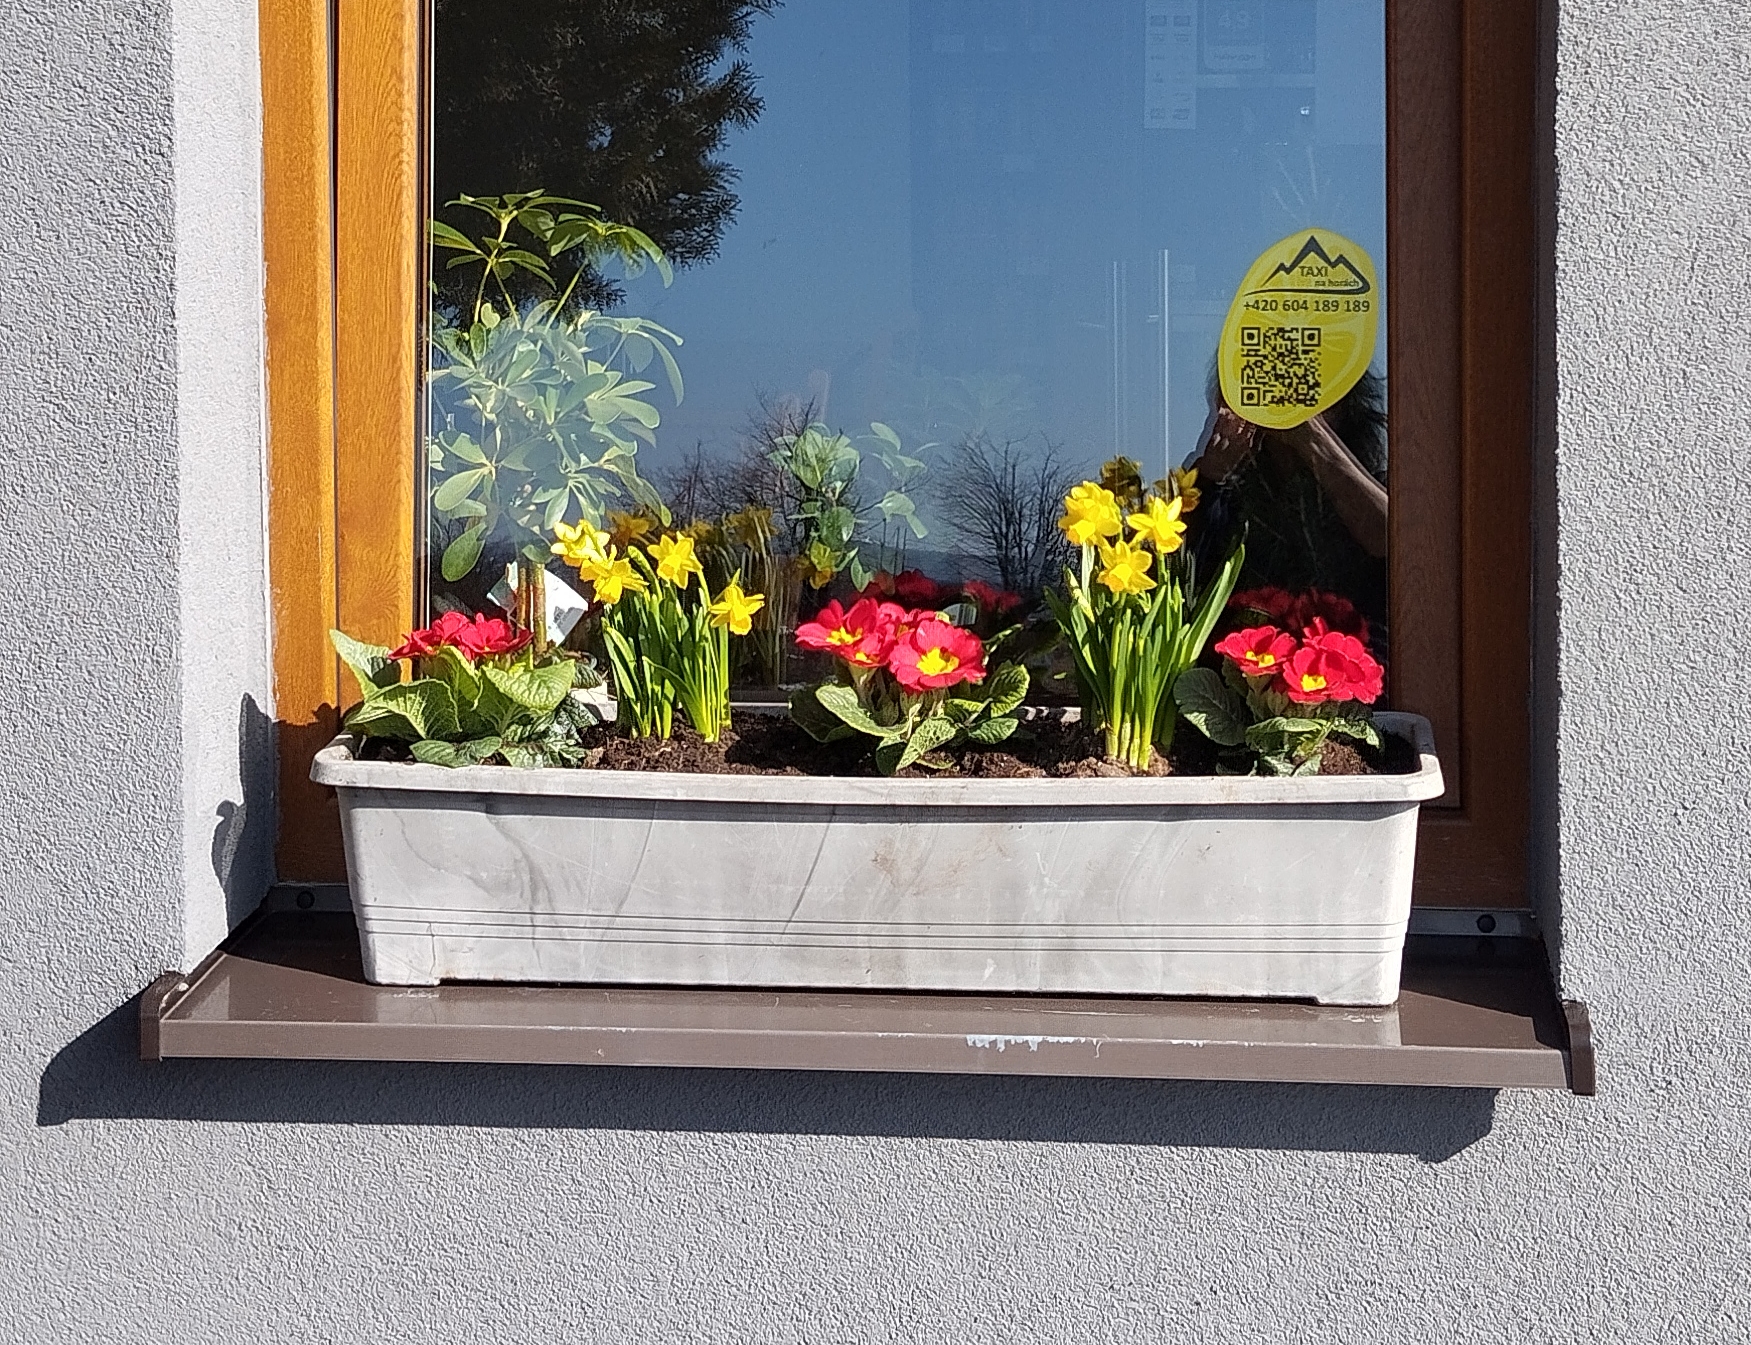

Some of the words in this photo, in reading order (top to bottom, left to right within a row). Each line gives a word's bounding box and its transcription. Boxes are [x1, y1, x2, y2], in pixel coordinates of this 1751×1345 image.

[1299, 266, 1328, 278] TAXI
[1243, 300, 1277, 312] +420
[1282, 300, 1309, 312] 604
[1314, 300, 1339, 313] 189
[1345, 300, 1370, 313] 189
